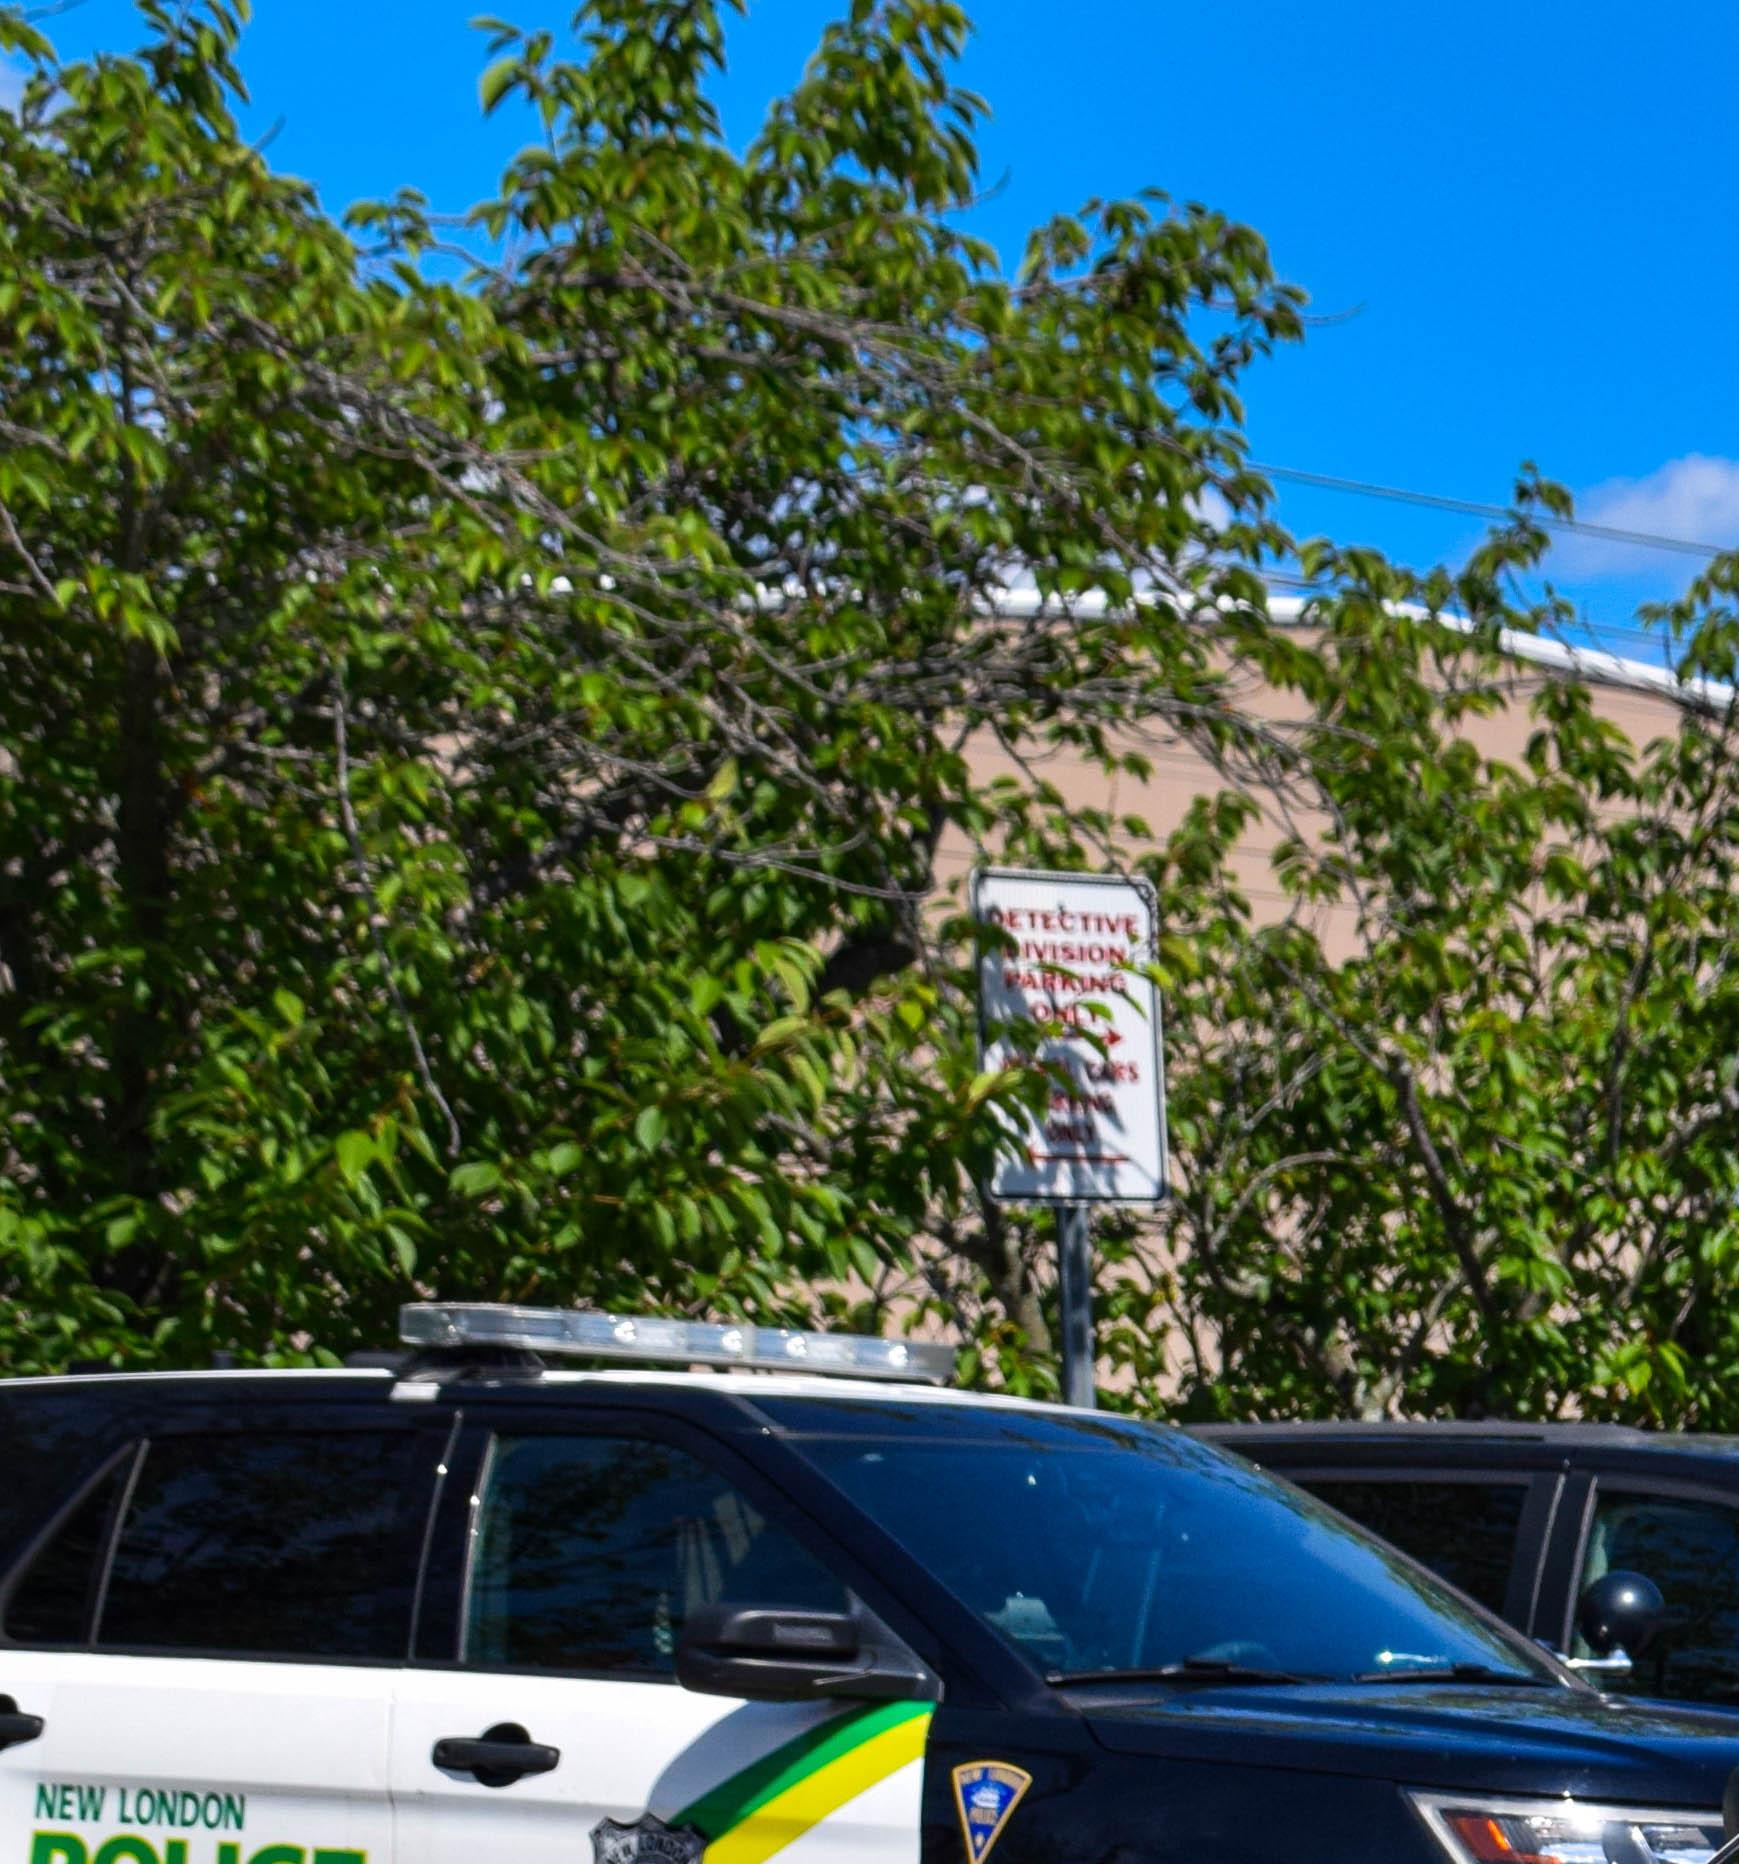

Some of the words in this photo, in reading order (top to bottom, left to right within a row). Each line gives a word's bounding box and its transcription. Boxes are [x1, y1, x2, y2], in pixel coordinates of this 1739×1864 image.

[988, 907, 1136, 934] DETECTIVE
[35, 1783, 106, 1821] NEW
[119, 1787, 246, 1830] LONDON
